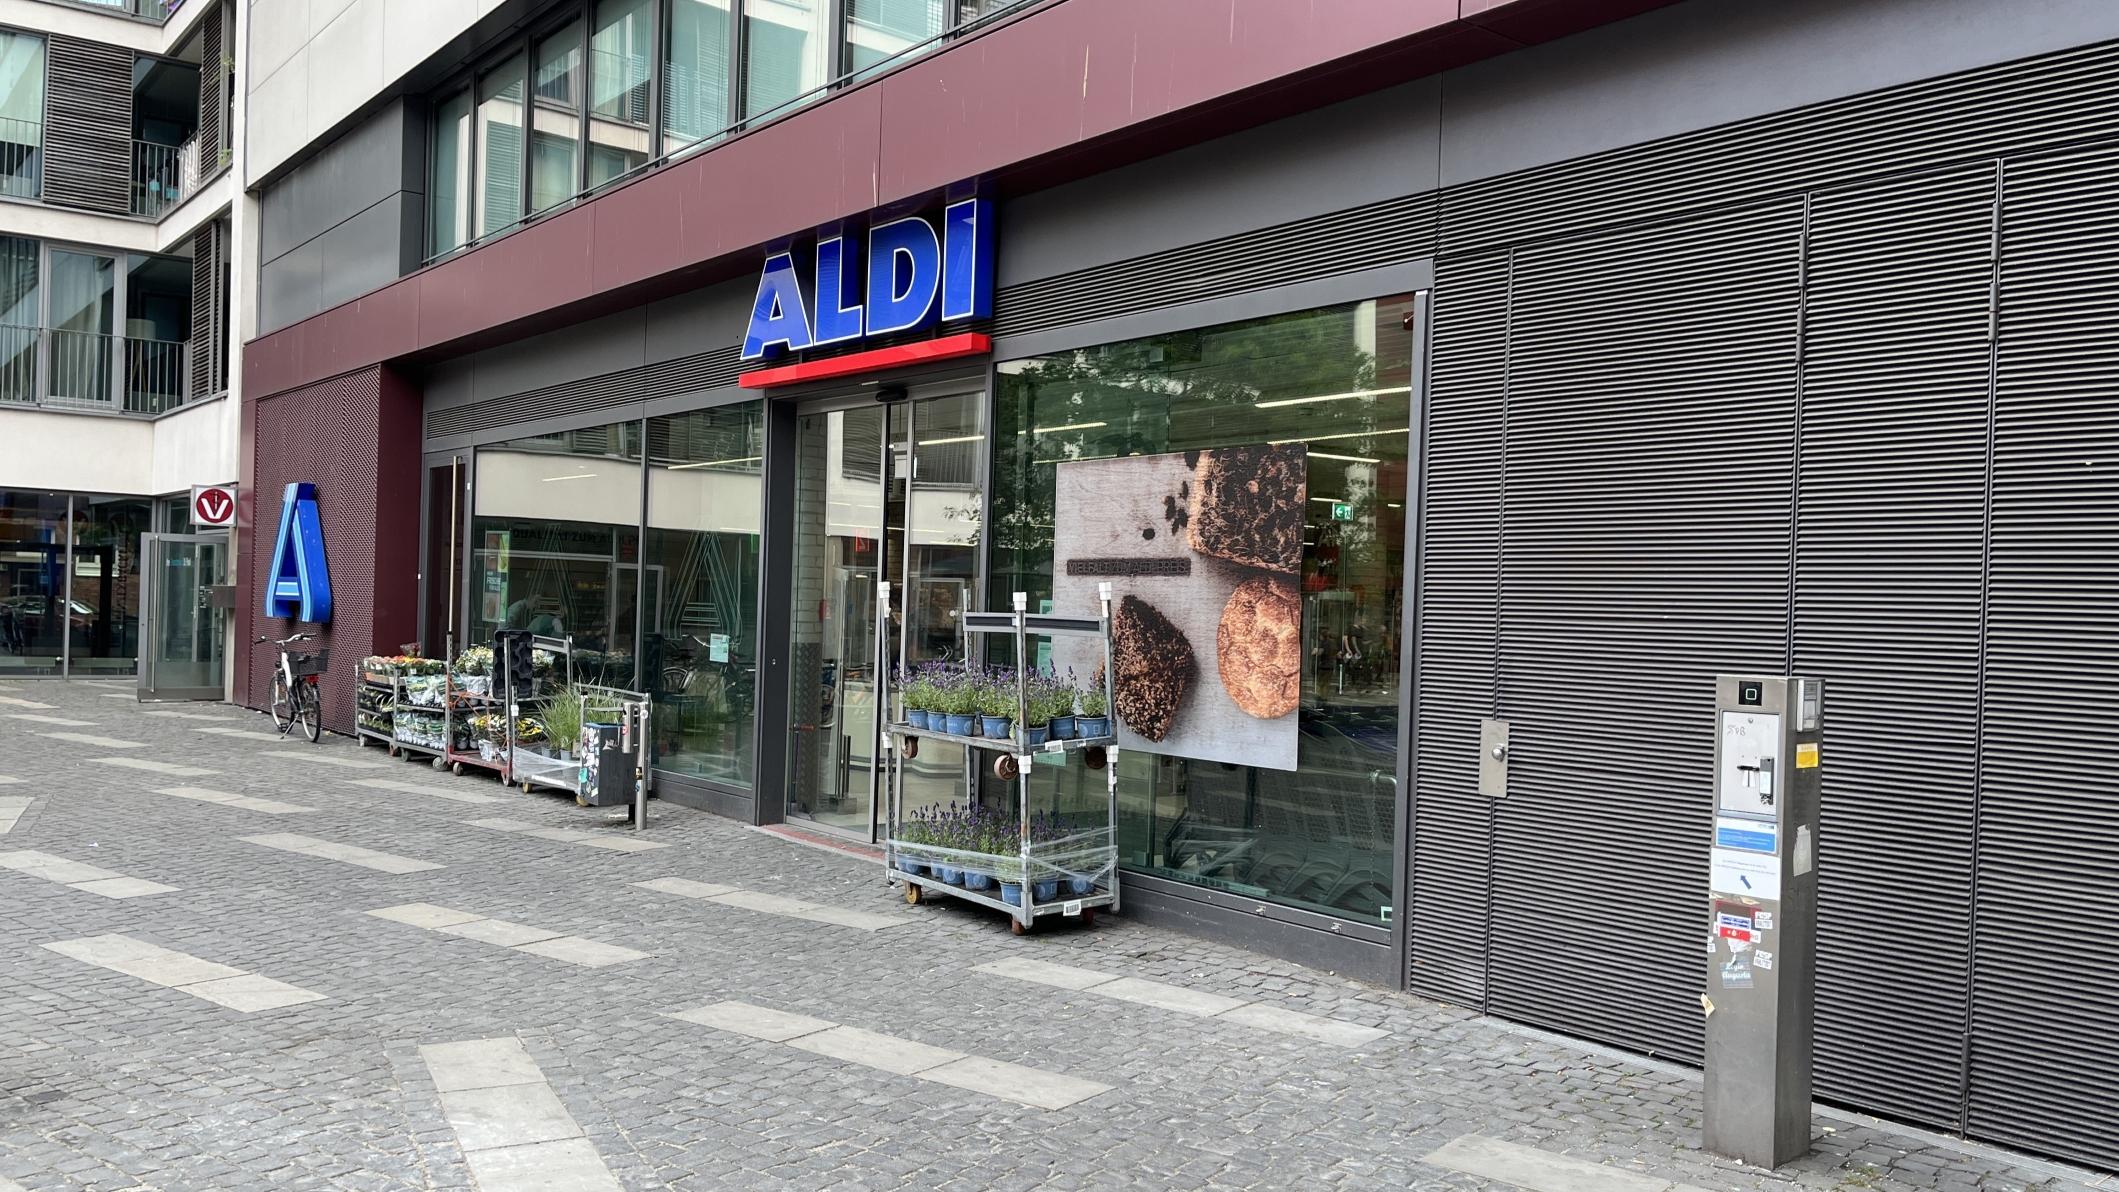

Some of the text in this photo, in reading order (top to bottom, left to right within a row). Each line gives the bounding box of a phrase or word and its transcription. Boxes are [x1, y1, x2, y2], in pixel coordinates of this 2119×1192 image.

[740, 198, 979, 360] ALDI
[266, 482, 331, 622] A
[1069, 561, 1109, 574] VIELFALT
